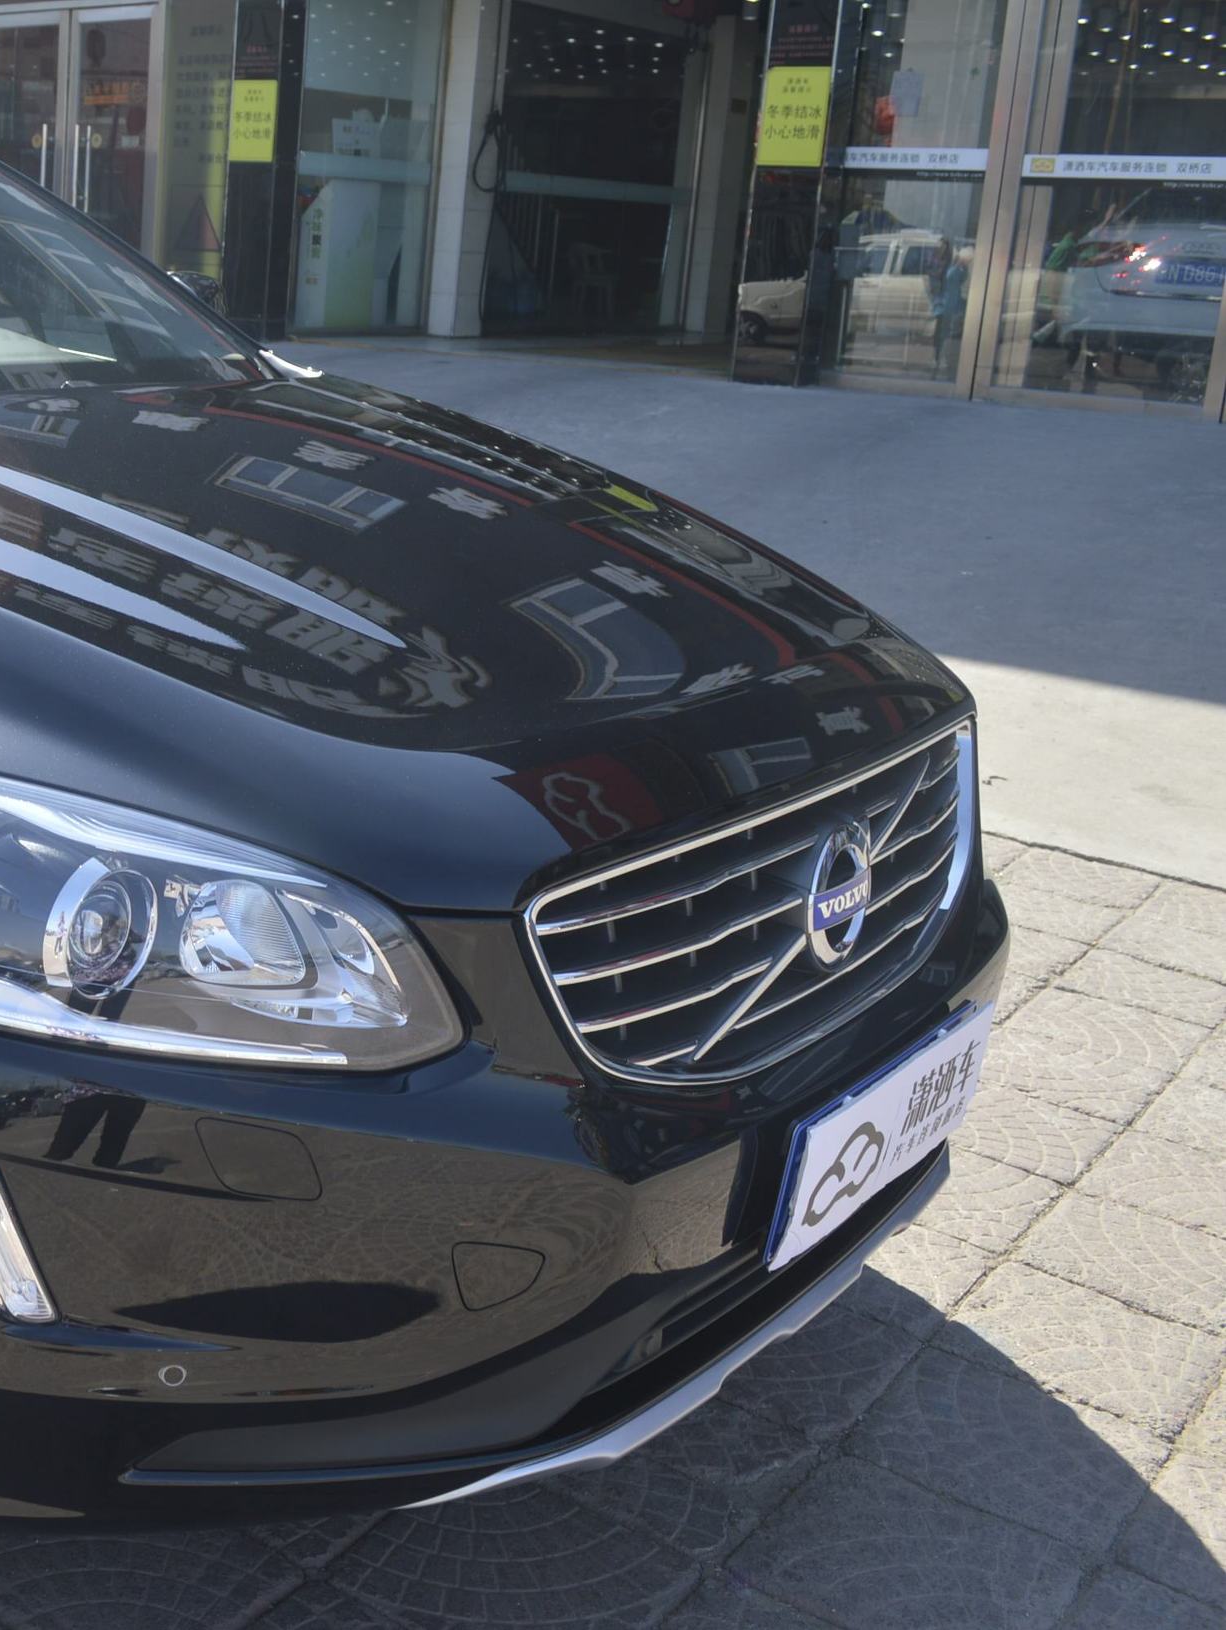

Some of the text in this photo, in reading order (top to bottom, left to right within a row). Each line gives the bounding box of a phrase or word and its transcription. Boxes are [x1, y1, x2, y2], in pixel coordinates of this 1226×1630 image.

[235, 111, 272, 123] 冬季结冰
[767, 104, 822, 119] 冬季结冰
[233, 128, 272, 140] 小心地滑
[765, 124, 820, 140] 小心地滑
[1063, 160, 1214, 174] 潇洒车汽车服务连锁 双桥店
[817, 879, 869, 918] VOLVO
[900, 1039, 981, 1137] 潇洒车
